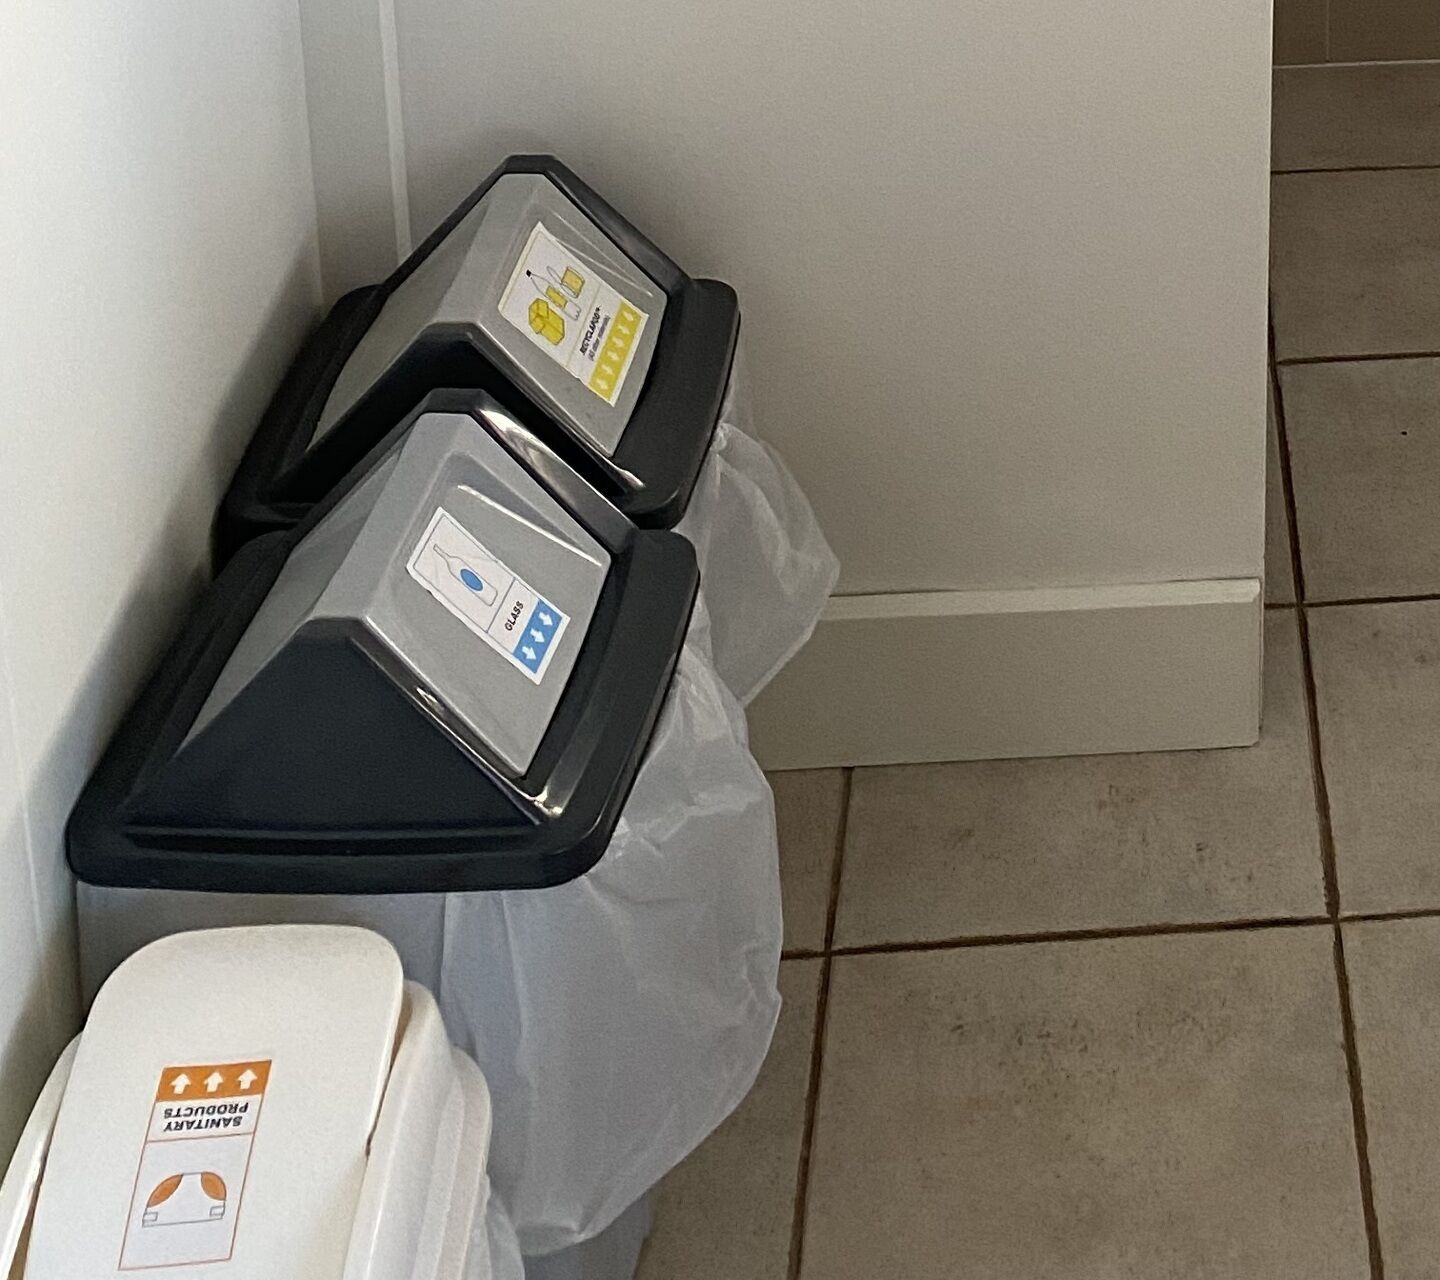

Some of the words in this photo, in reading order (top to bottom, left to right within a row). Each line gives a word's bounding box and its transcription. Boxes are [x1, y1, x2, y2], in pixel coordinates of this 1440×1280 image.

[504, 600, 524, 631] GLASS
[163, 1101, 249, 1120] PRODUCTS
[163, 1115, 243, 1132] SANITARY
